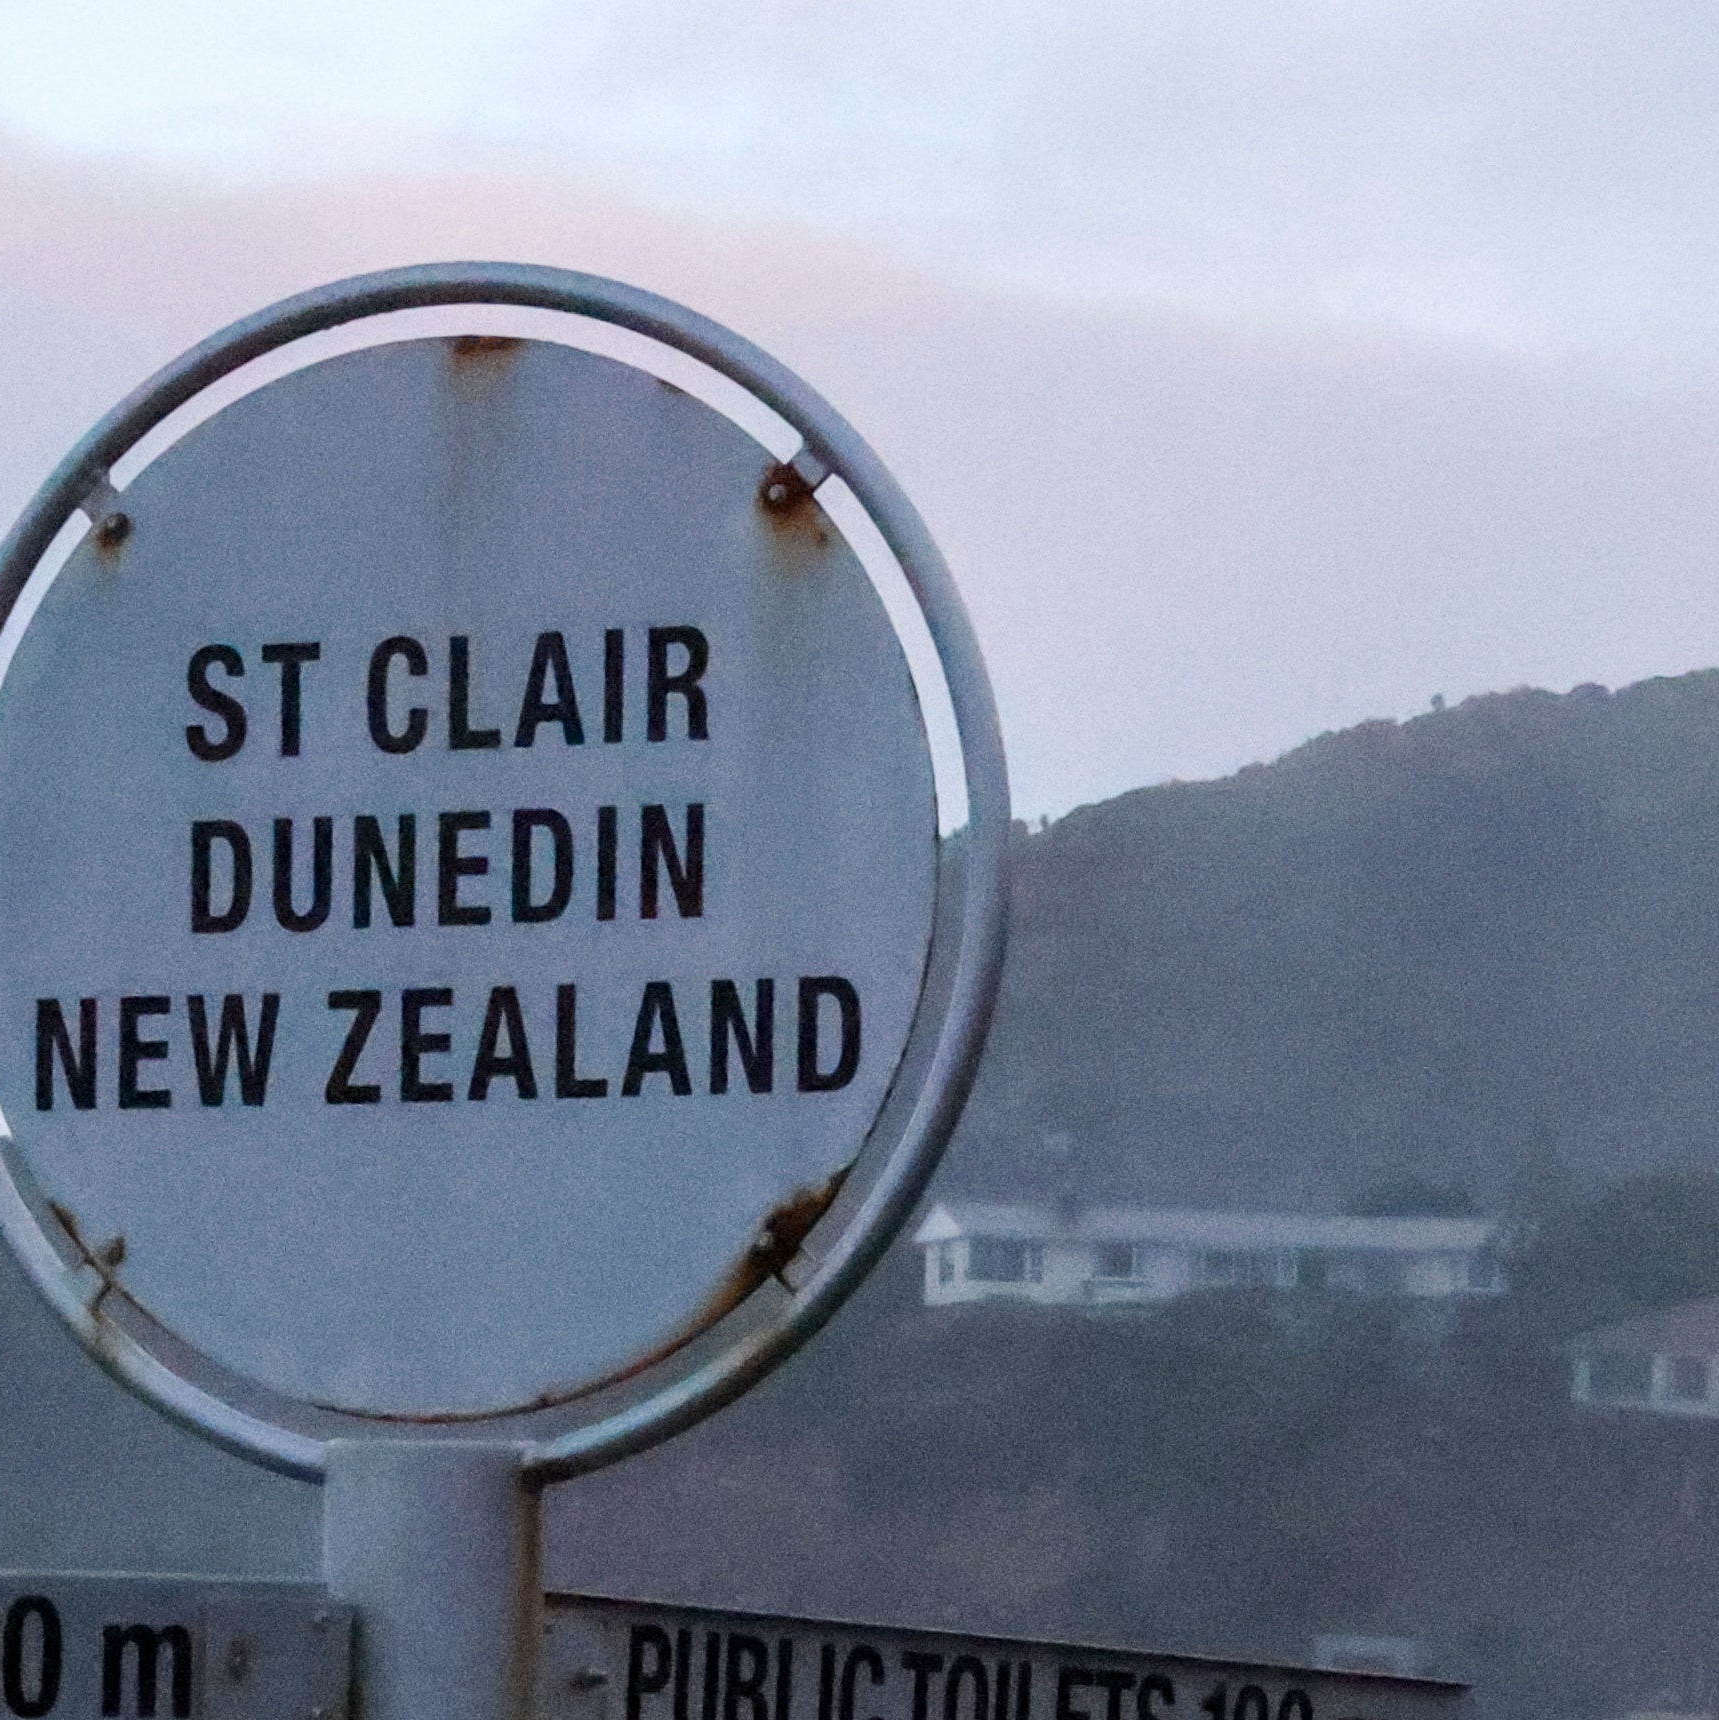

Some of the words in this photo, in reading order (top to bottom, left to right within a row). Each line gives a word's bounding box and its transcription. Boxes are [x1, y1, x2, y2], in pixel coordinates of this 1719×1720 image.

[185, 642, 319, 762] ST
[366, 625, 710, 756] CLAIR
[190, 804, 705, 934] DUNEDIN
[34, 993, 280, 1111] NEW
[324, 976, 862, 1104] ZEALAND
[105, 1618, 193, 1720] m
